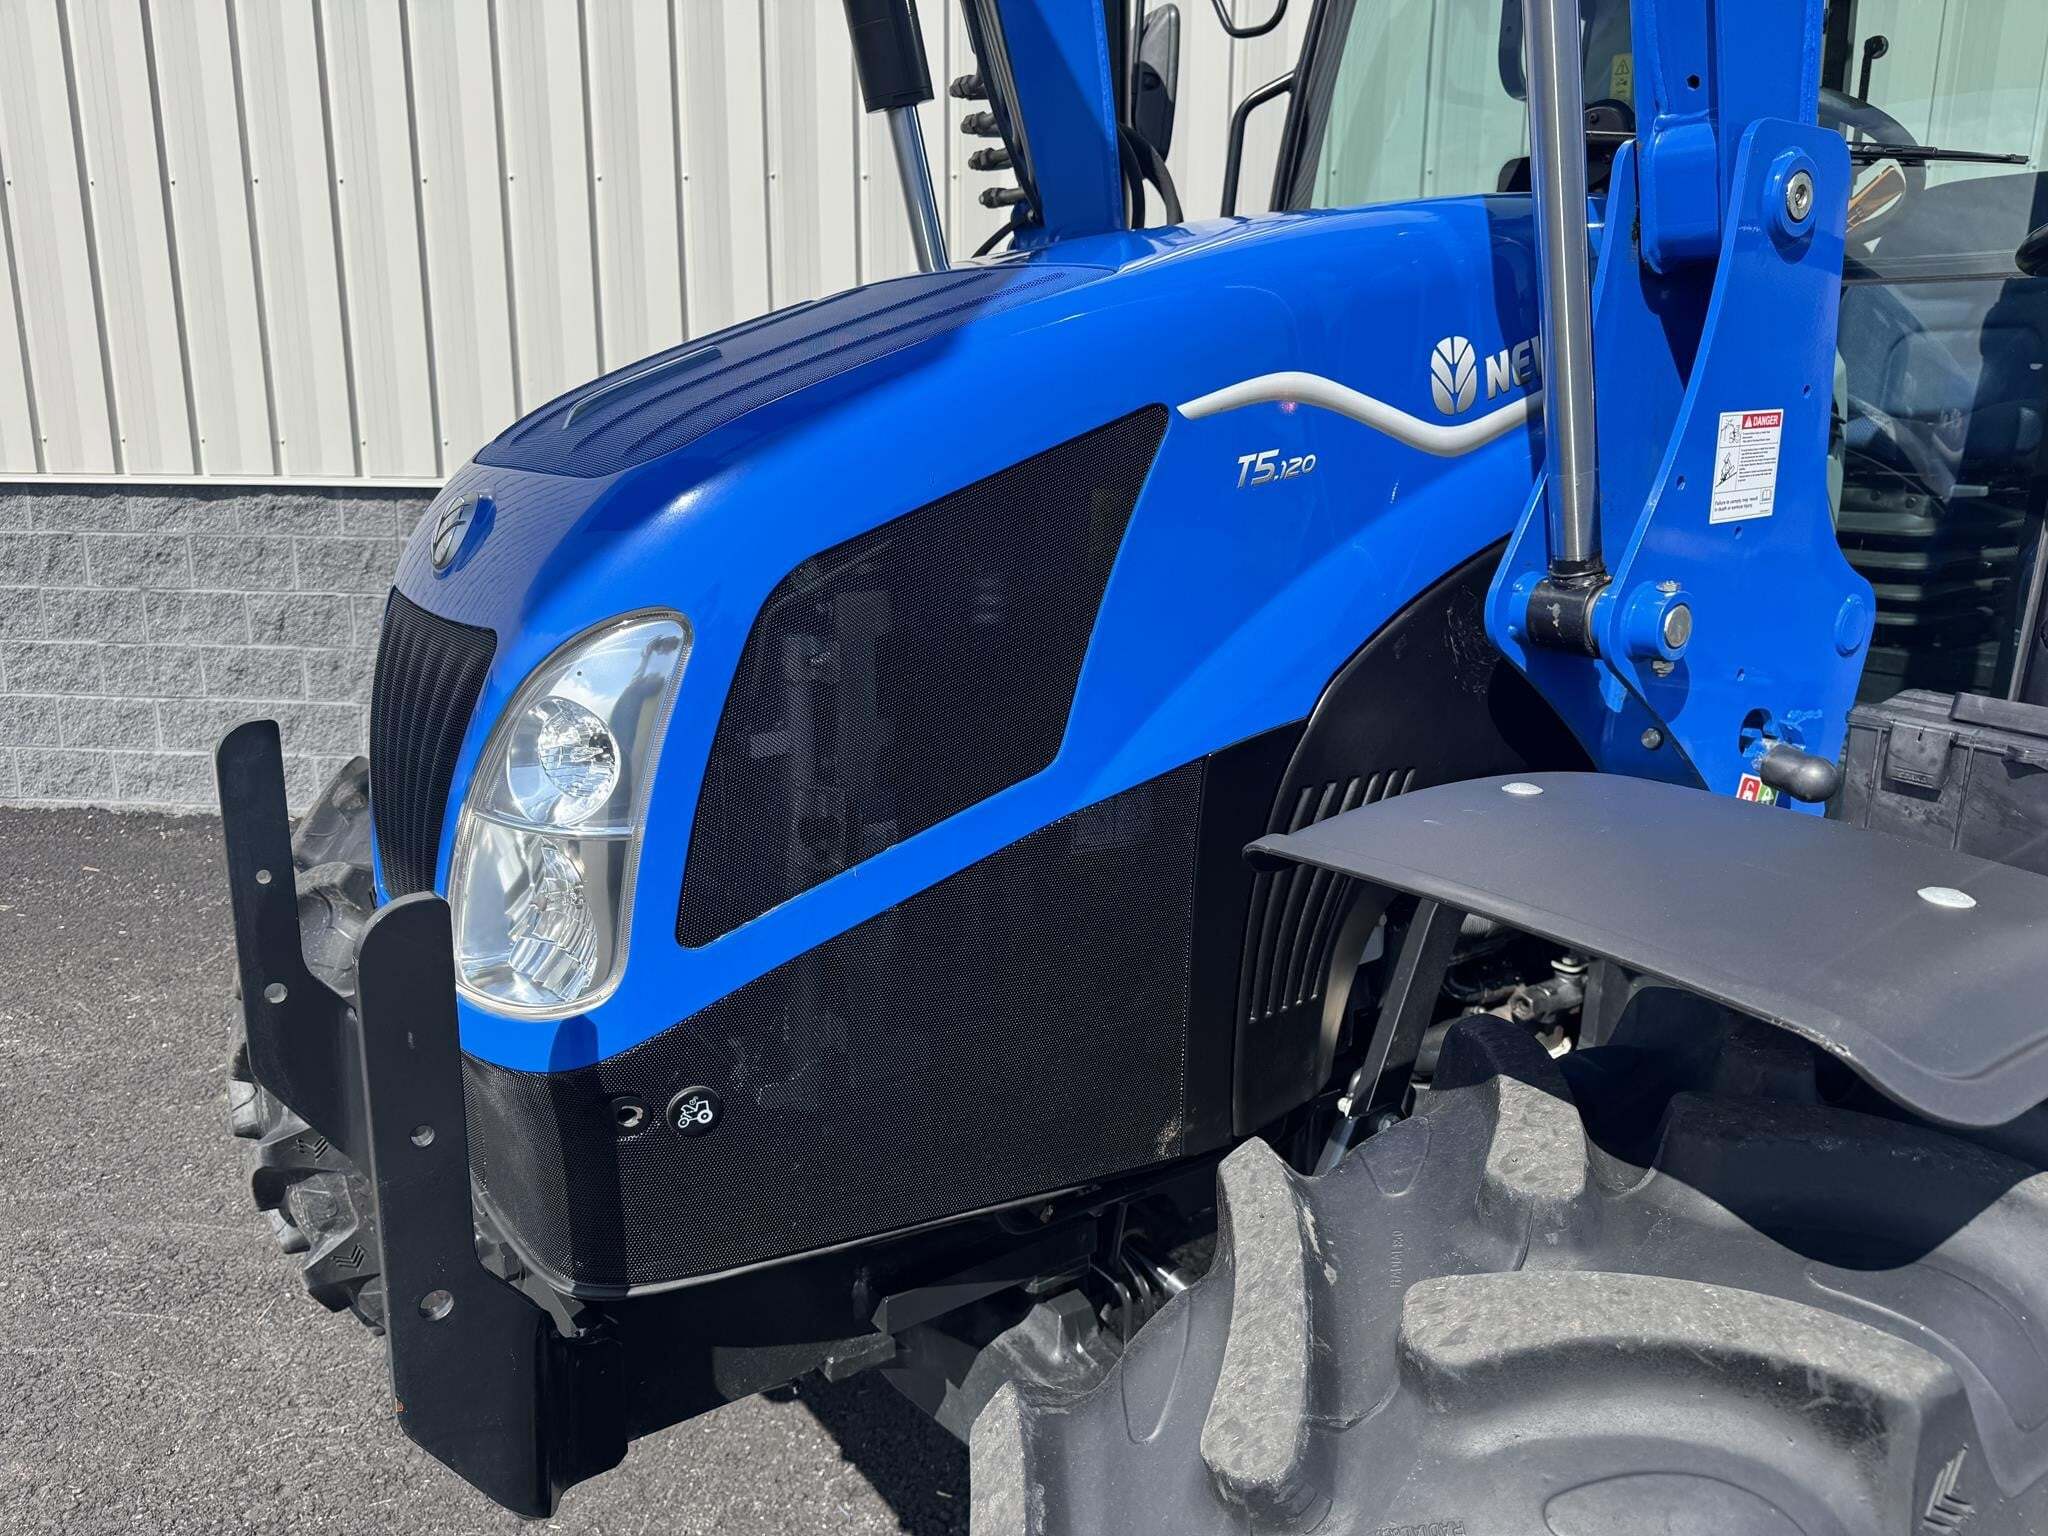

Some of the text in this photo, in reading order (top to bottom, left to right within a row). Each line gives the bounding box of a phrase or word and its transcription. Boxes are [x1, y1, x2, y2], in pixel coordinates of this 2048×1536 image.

[1485, 336, 1541, 400] NE
[1753, 415, 1778, 427] DANGER
[1237, 448, 1317, 489] T5.120
